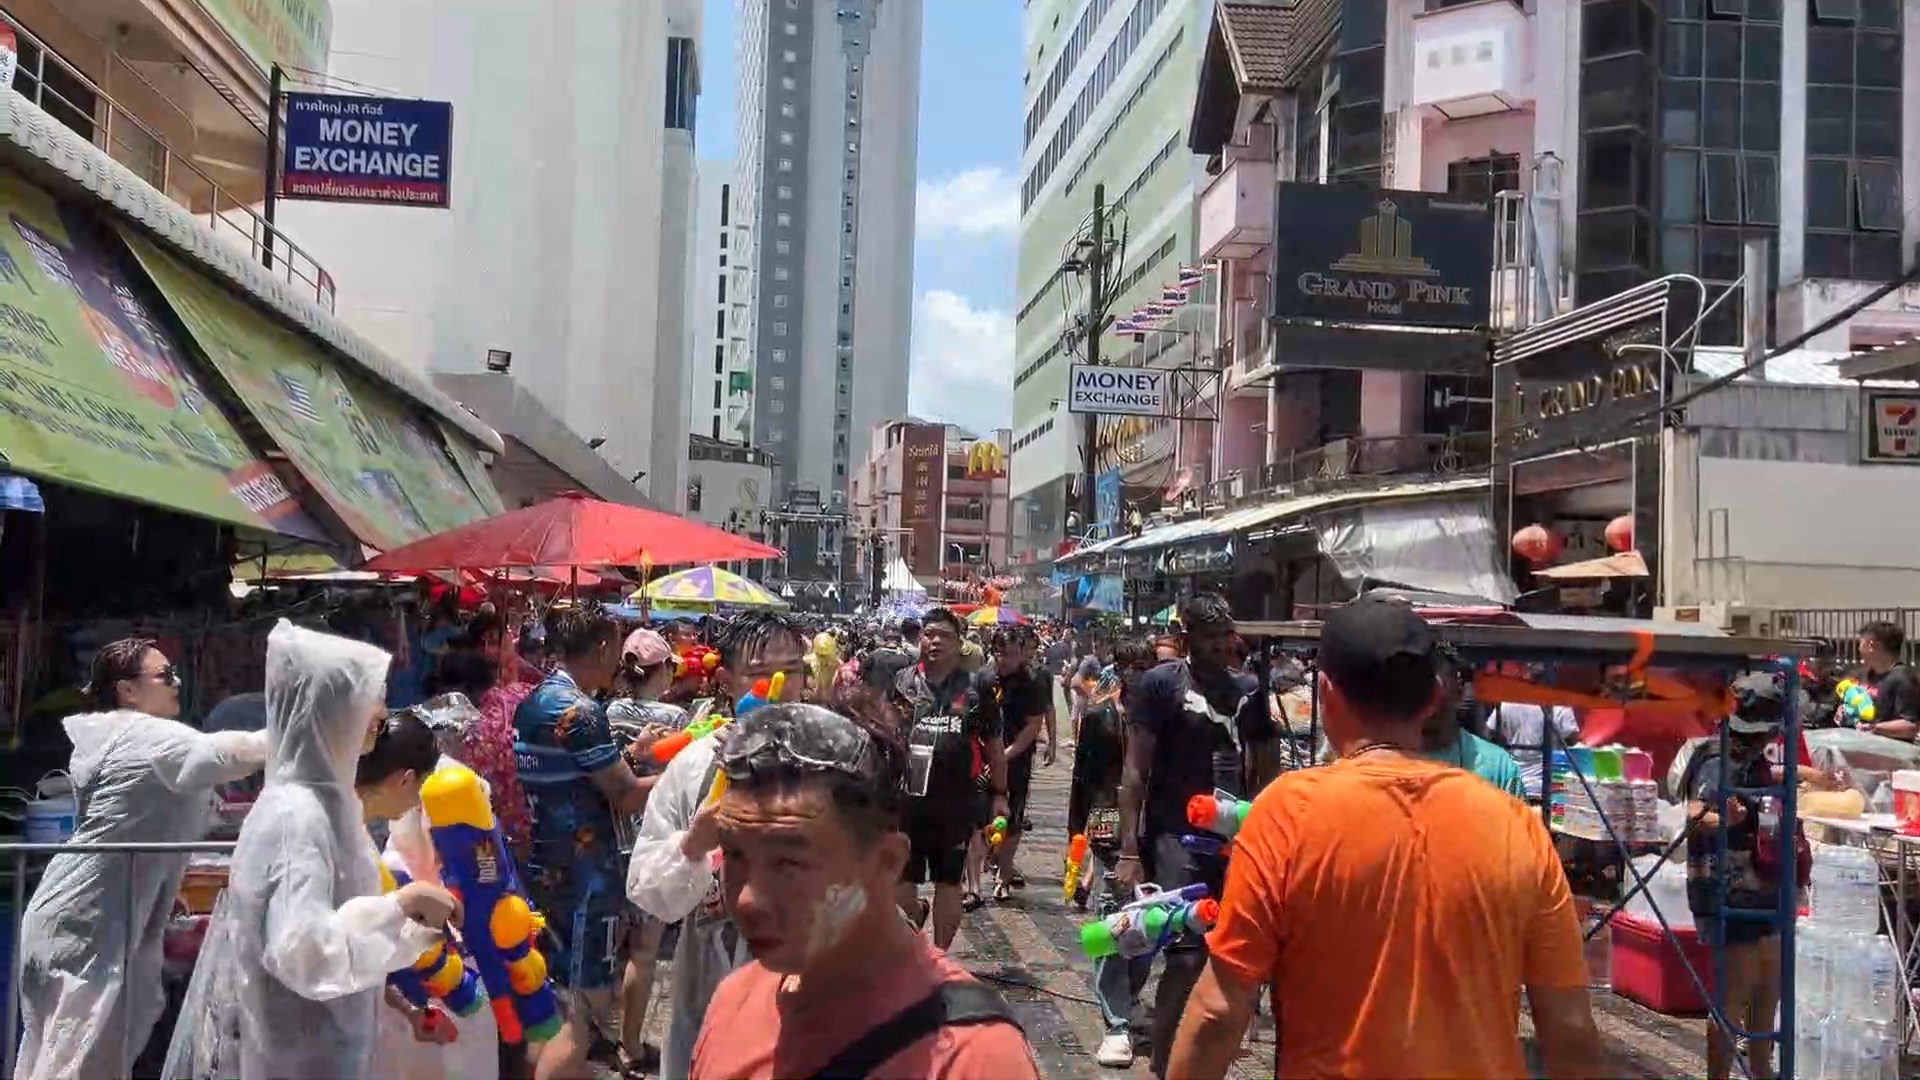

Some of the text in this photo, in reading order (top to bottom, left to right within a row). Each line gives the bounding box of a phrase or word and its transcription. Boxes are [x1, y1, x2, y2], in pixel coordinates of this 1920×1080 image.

[343, 103, 360, 114] JR
[320, 118, 418, 147] MONEY
[294, 146, 439, 179] EXCHANGE
[1297, 271, 1471, 305] GRAND PINK
[1367, 301, 1402, 314] Hotel
[1076, 371, 1160, 391] MONEY
[1075, 391, 1159, 406] EXCHANGE
